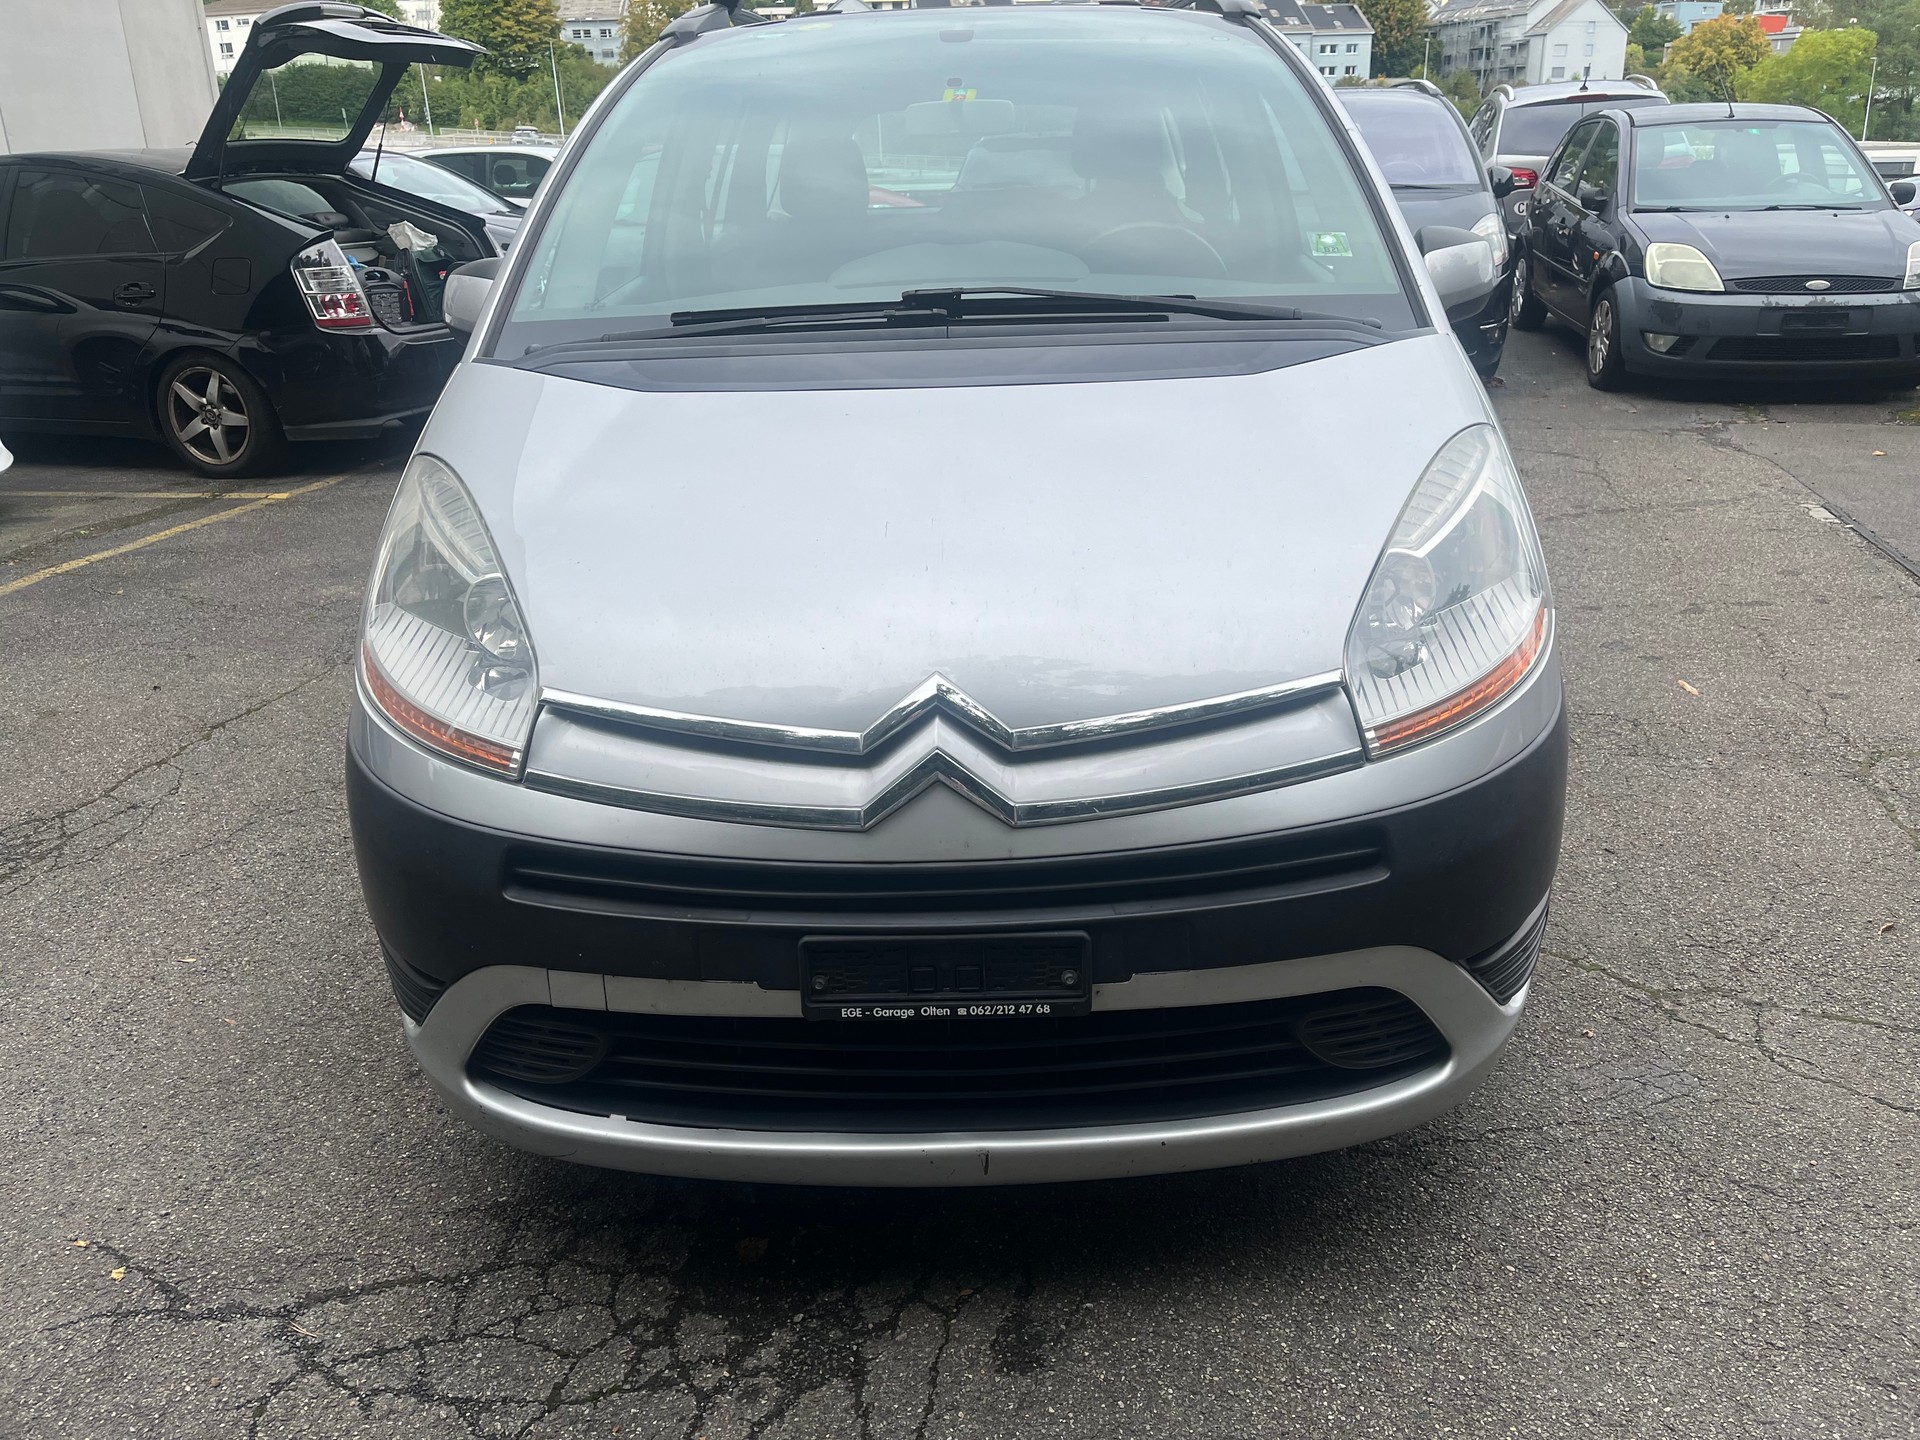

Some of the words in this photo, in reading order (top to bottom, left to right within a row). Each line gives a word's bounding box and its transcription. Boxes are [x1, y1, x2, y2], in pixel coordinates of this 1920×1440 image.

[841, 1007, 863, 1018] EGE
[873, 1007, 915, 1019] Garage
[920, 1006, 950, 1016] Olten
[969, 1004, 1016, 1016] 062/212
[1018, 1004, 1033, 1014] 47
[1036, 1004, 1051, 1014] 68
